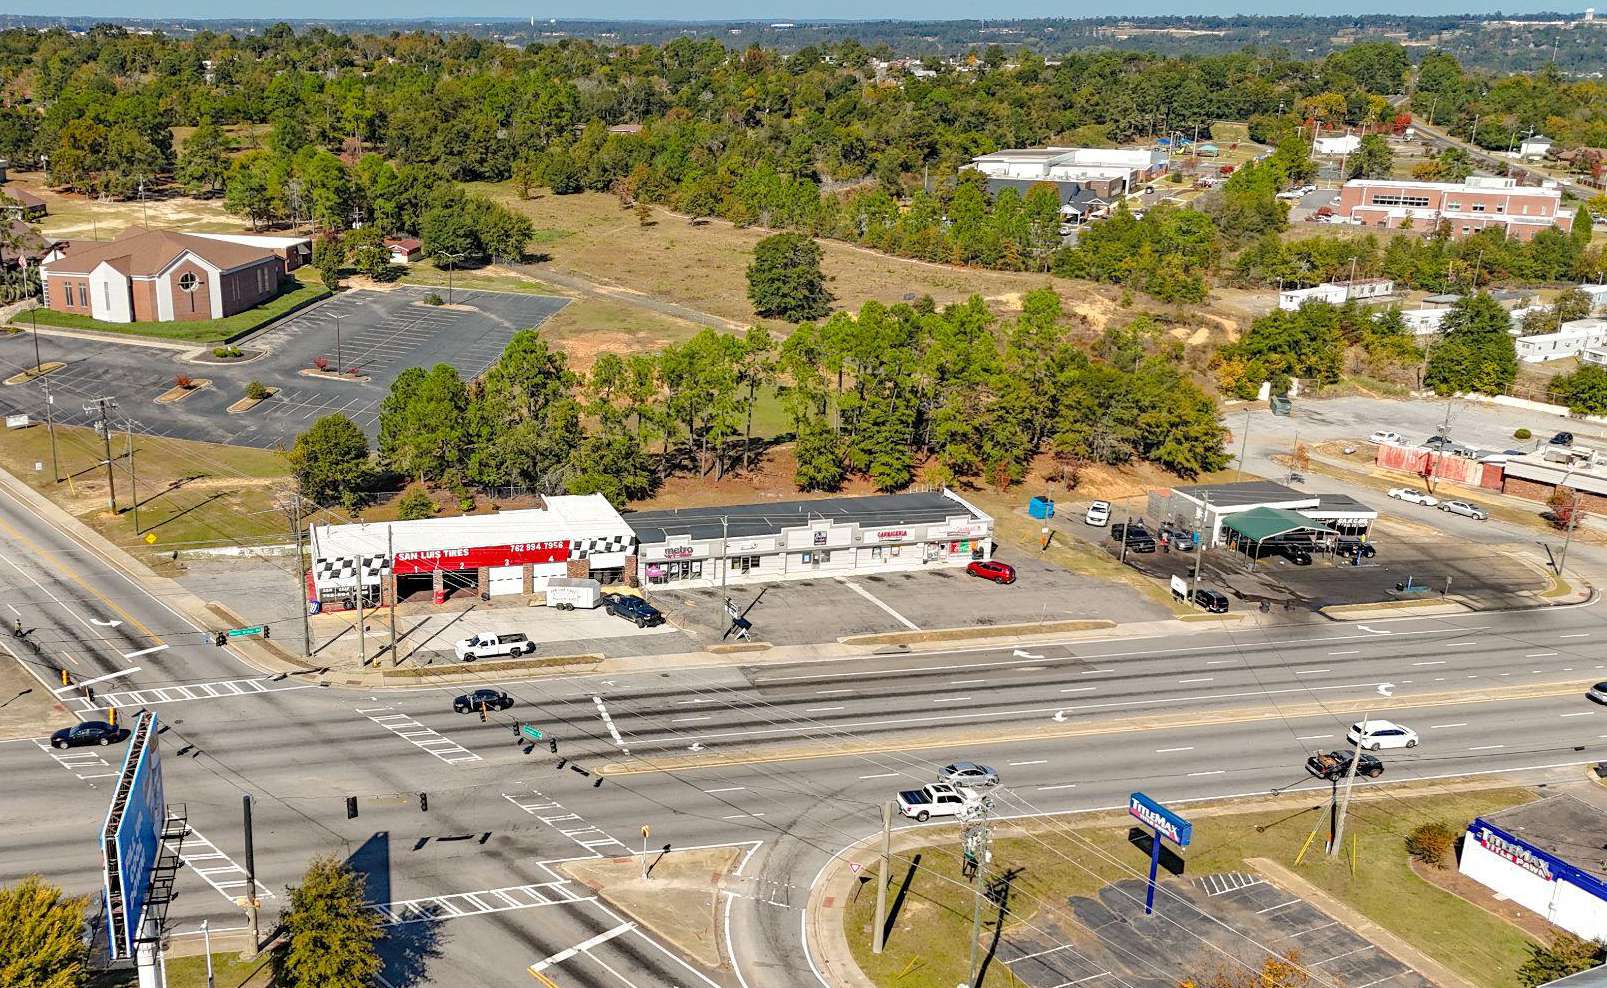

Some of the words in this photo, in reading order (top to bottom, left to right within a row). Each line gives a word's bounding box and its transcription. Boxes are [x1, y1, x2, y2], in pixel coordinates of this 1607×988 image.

[510, 544, 524, 552] 762
[544, 540, 563, 550] 7956
[664, 545, 693, 554] metro
[398, 552, 418, 561] SAN
[420, 550, 441, 559] LUIS
[443, 548, 469, 557] TIRES
[548, 555, 554, 563] 4
[459, 562, 465, 570] 2
[504, 558, 510, 567] 3
[1486, 843, 1513, 861] TITLE
[1516, 858, 1546, 879] PAWN
